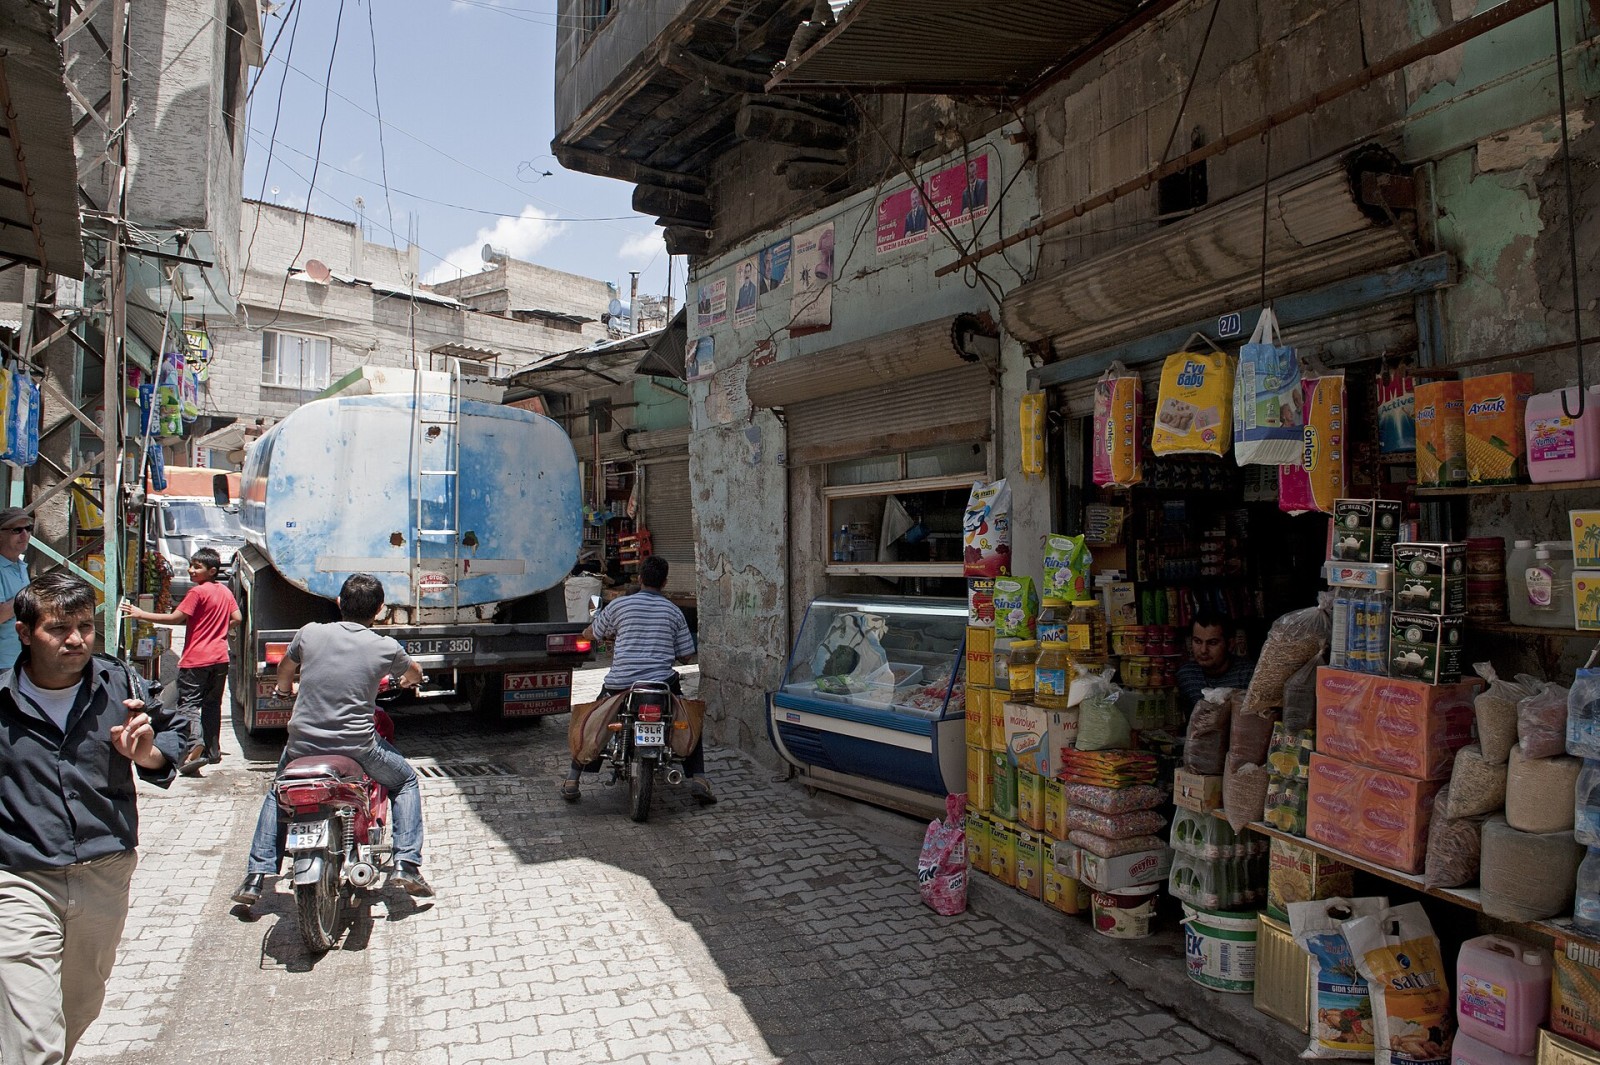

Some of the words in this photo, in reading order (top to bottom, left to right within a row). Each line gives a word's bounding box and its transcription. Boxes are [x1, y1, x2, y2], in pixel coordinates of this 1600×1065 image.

[1184, 360, 1206, 375] Evy
[1177, 373, 1205, 388] Baby
[1381, 396, 1414, 413] Active
[1468, 400, 1505, 415] AYMAR
[1304, 429, 1315, 468] önlem
[1044, 556, 1070, 568] Rinso
[994, 598, 1022, 609] Rinso
[407, 641, 421, 654] 63
[429, 640, 443, 653] LF
[449, 639, 470, 652] 350
[967, 652, 993, 662] EVET
[513, 690, 559, 700] Cummins
[990, 827, 1008, 841] Turna
[1017, 838, 1036, 852] Turna
[1331, 985, 1347, 993] GIDA
